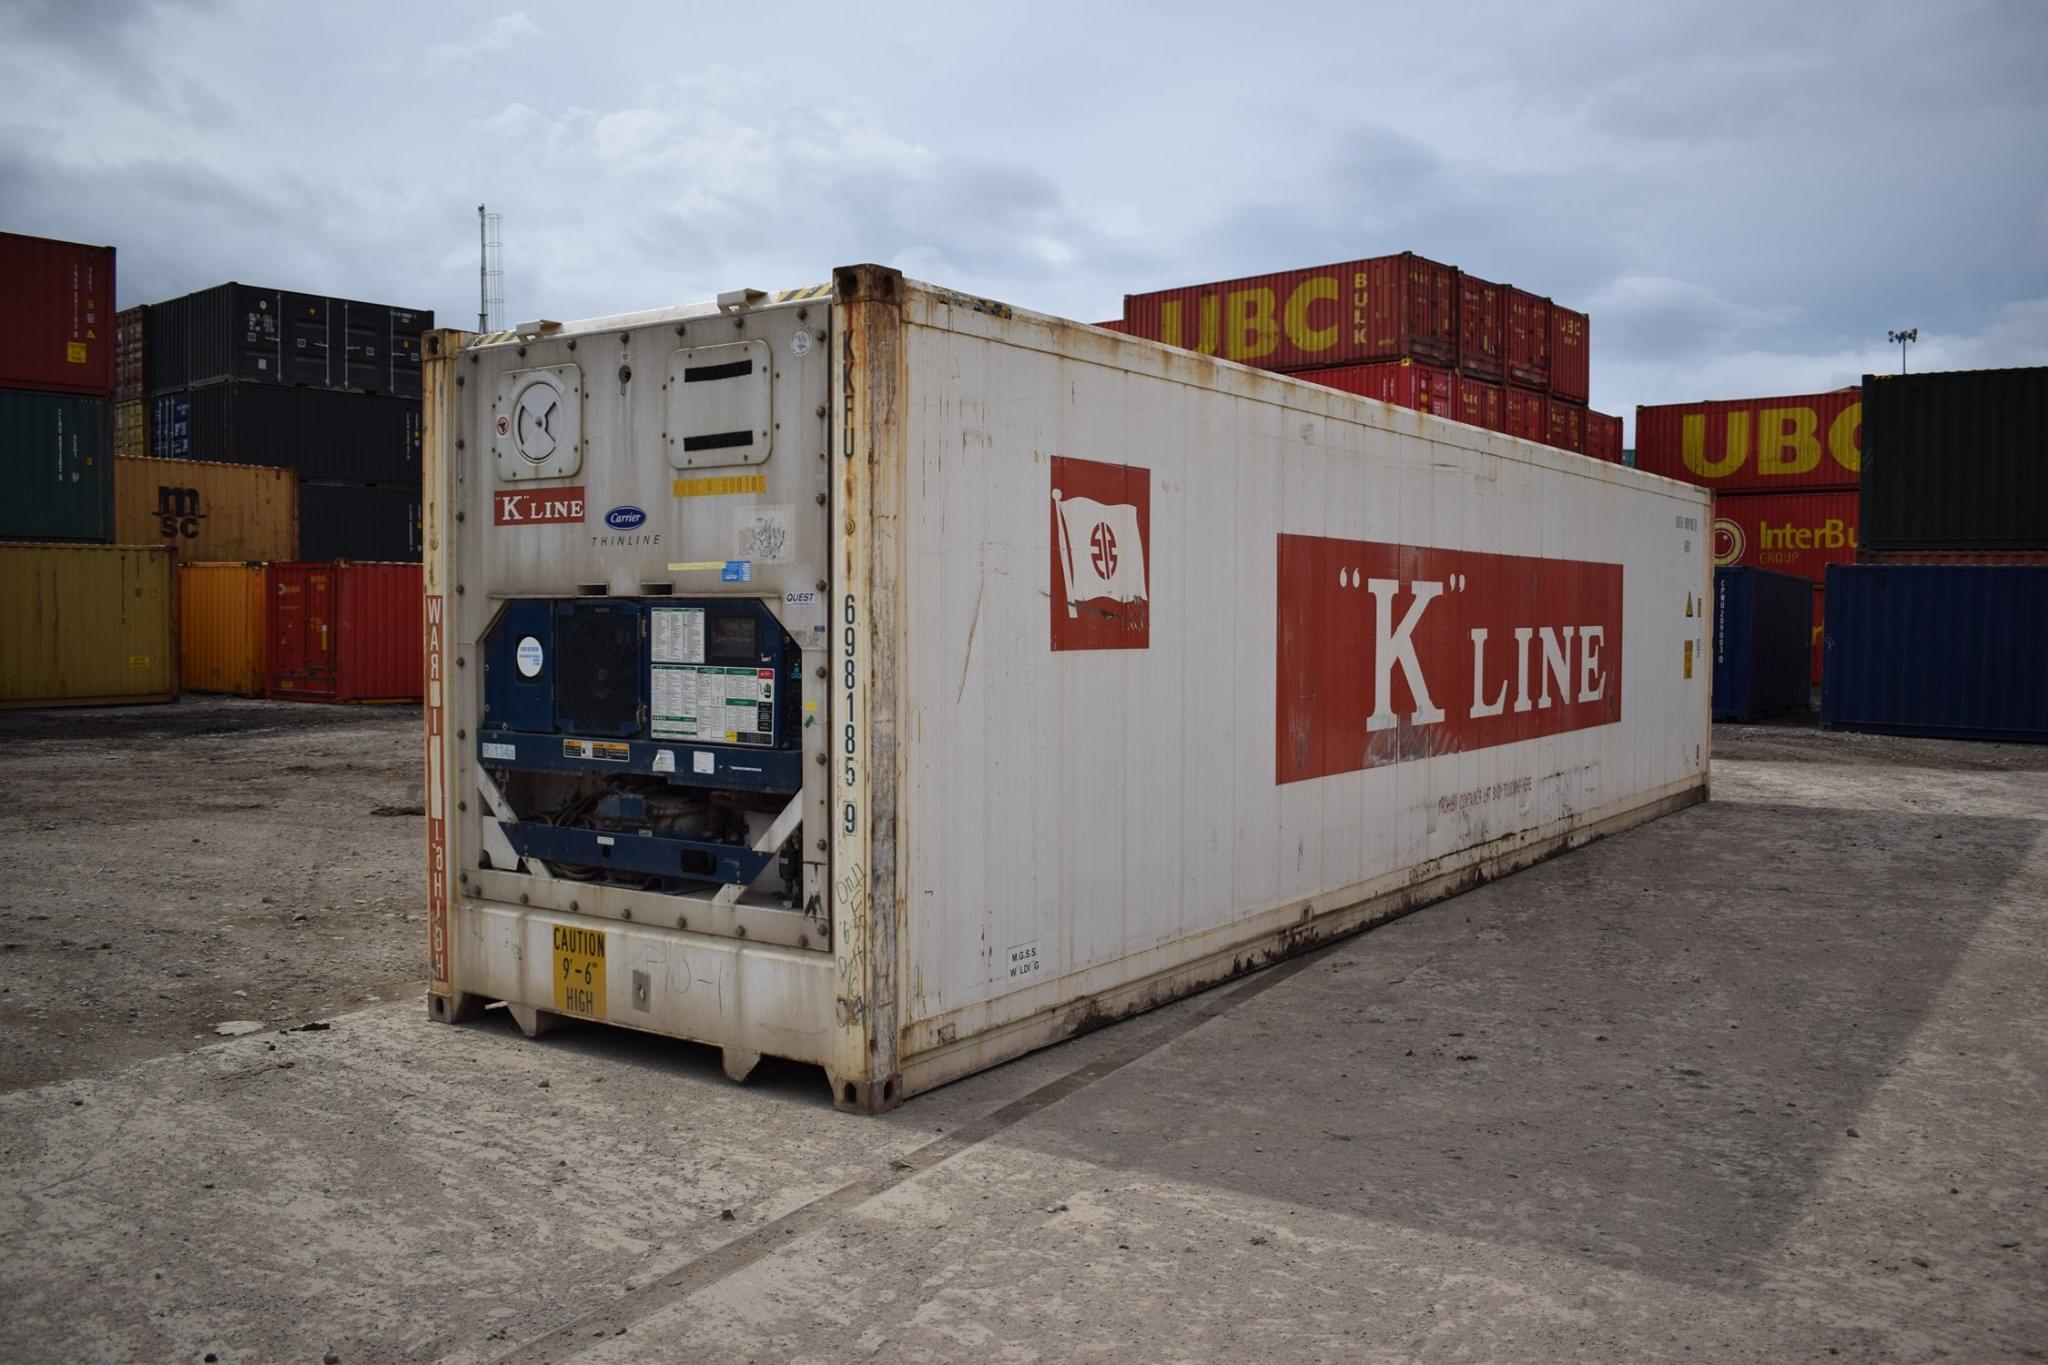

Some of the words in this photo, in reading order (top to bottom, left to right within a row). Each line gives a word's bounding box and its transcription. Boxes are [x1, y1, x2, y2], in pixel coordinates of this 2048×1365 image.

[1162, 277, 1339, 361] UBC
[1353, 272, 1369, 345] BULK
[843, 330, 855, 458] KKFU
[530, 500, 584, 519] LINE
[610, 512, 641, 524] Carrier
[591, 534, 661, 547] THINLINE
[1760, 551, 1800, 564] GROUP
[786, 593, 815, 603] QUEST
[1469, 625, 1606, 719] LINE
[844, 594, 856, 787] 698185
[845, 803, 855, 833] 9
[553, 926, 606, 959] CAUTION
[566, 986, 594, 1015] HIGH
